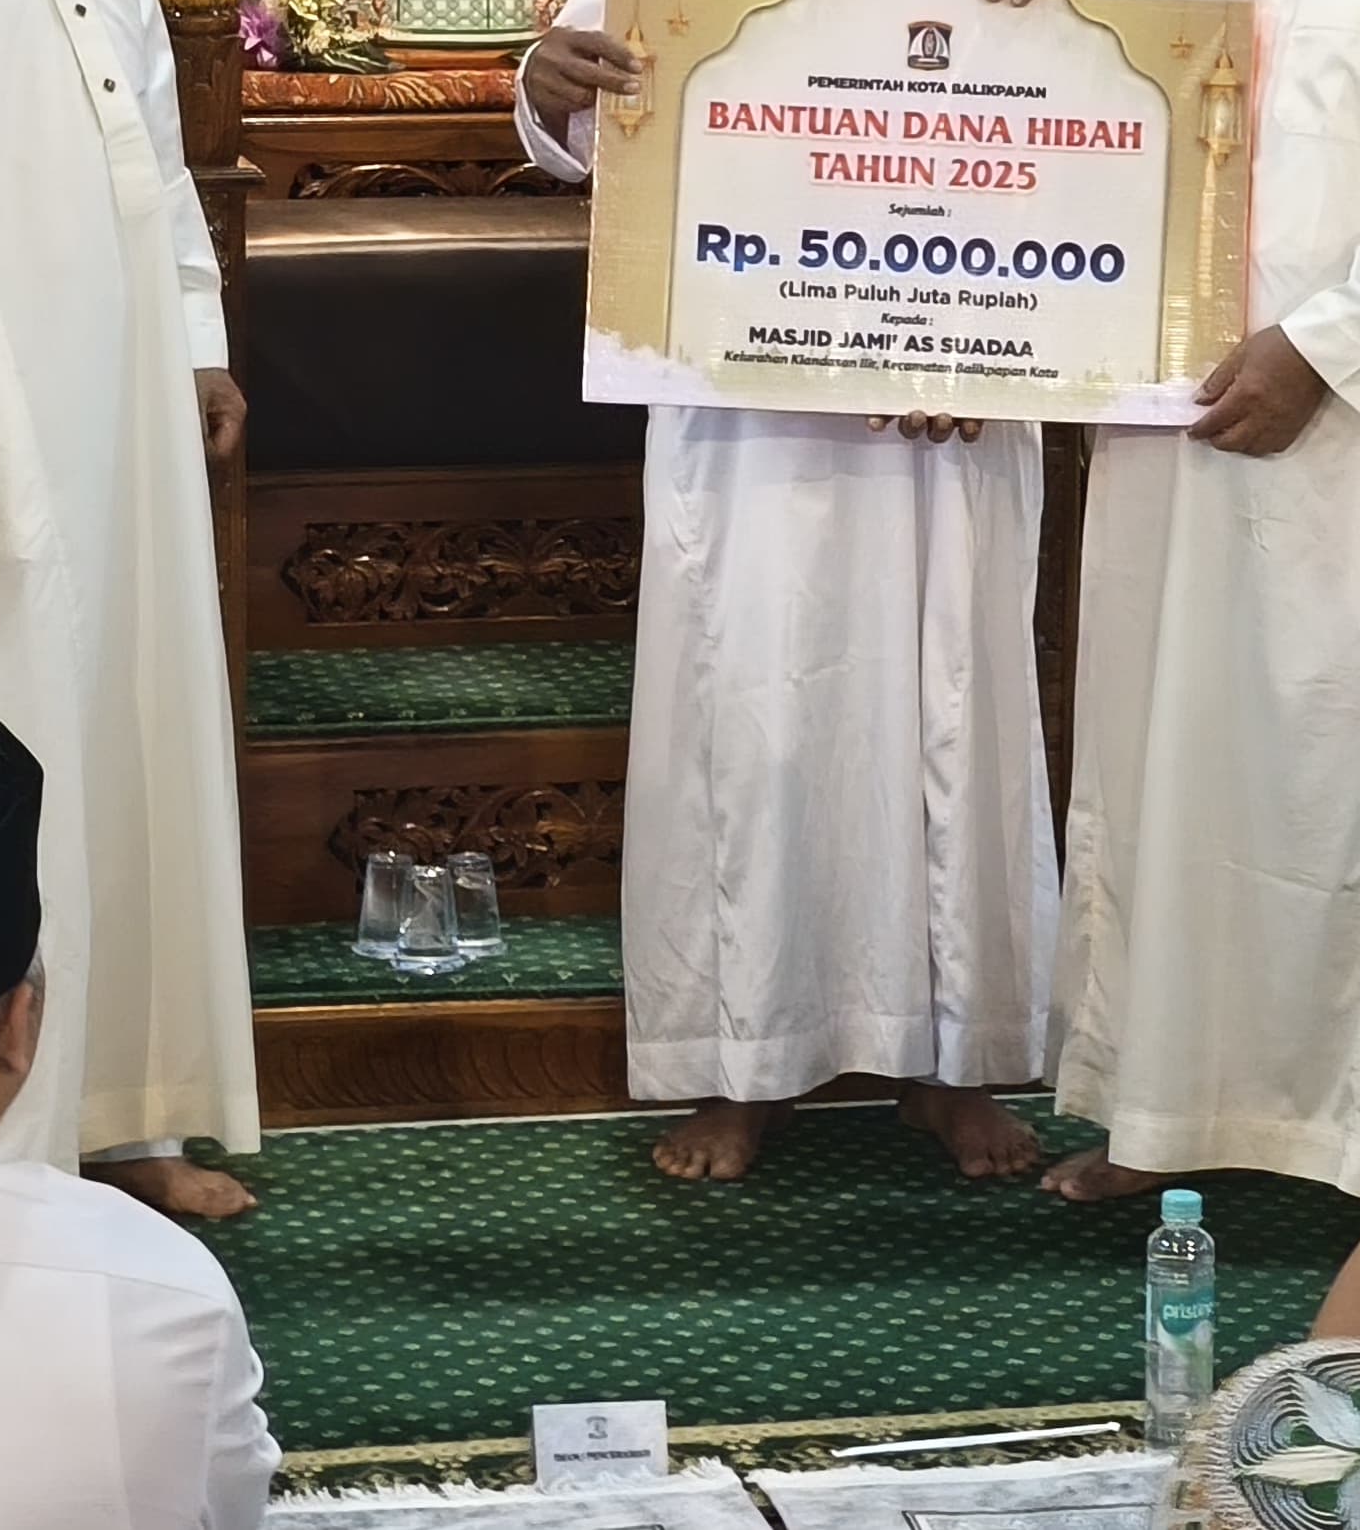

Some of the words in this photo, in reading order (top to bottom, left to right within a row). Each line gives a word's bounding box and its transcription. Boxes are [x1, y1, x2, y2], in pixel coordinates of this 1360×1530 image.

[808, 76, 904, 91] PEMERINTAH
[908, 81, 947, 94] KOTA
[952, 83, 1046, 98] BALIKPAPAN
[708, 102, 888, 140] BANTUAN
[903, 112, 1013, 144] DANA
[1027, 118, 1142, 149] HIBAH
[810, 152, 935, 185] TAHUN
[949, 159, 1036, 190] 2025
[888, 203, 945, 217] Sejumlah
[697, 224, 780, 272] Rp.
[798, 230, 1125, 284] 50.000.000
[780, 281, 837, 298] (Lima
[845, 284, 900, 302] Puluh
[907, 288, 950, 305] Juta
[958, 290, 1037, 311] Rupiah)
[881, 313, 927, 326] Kepada
[749, 327, 832, 347] MASJID
[904, 335, 934, 352] AS
[941, 337, 1033, 358] SUADAA
